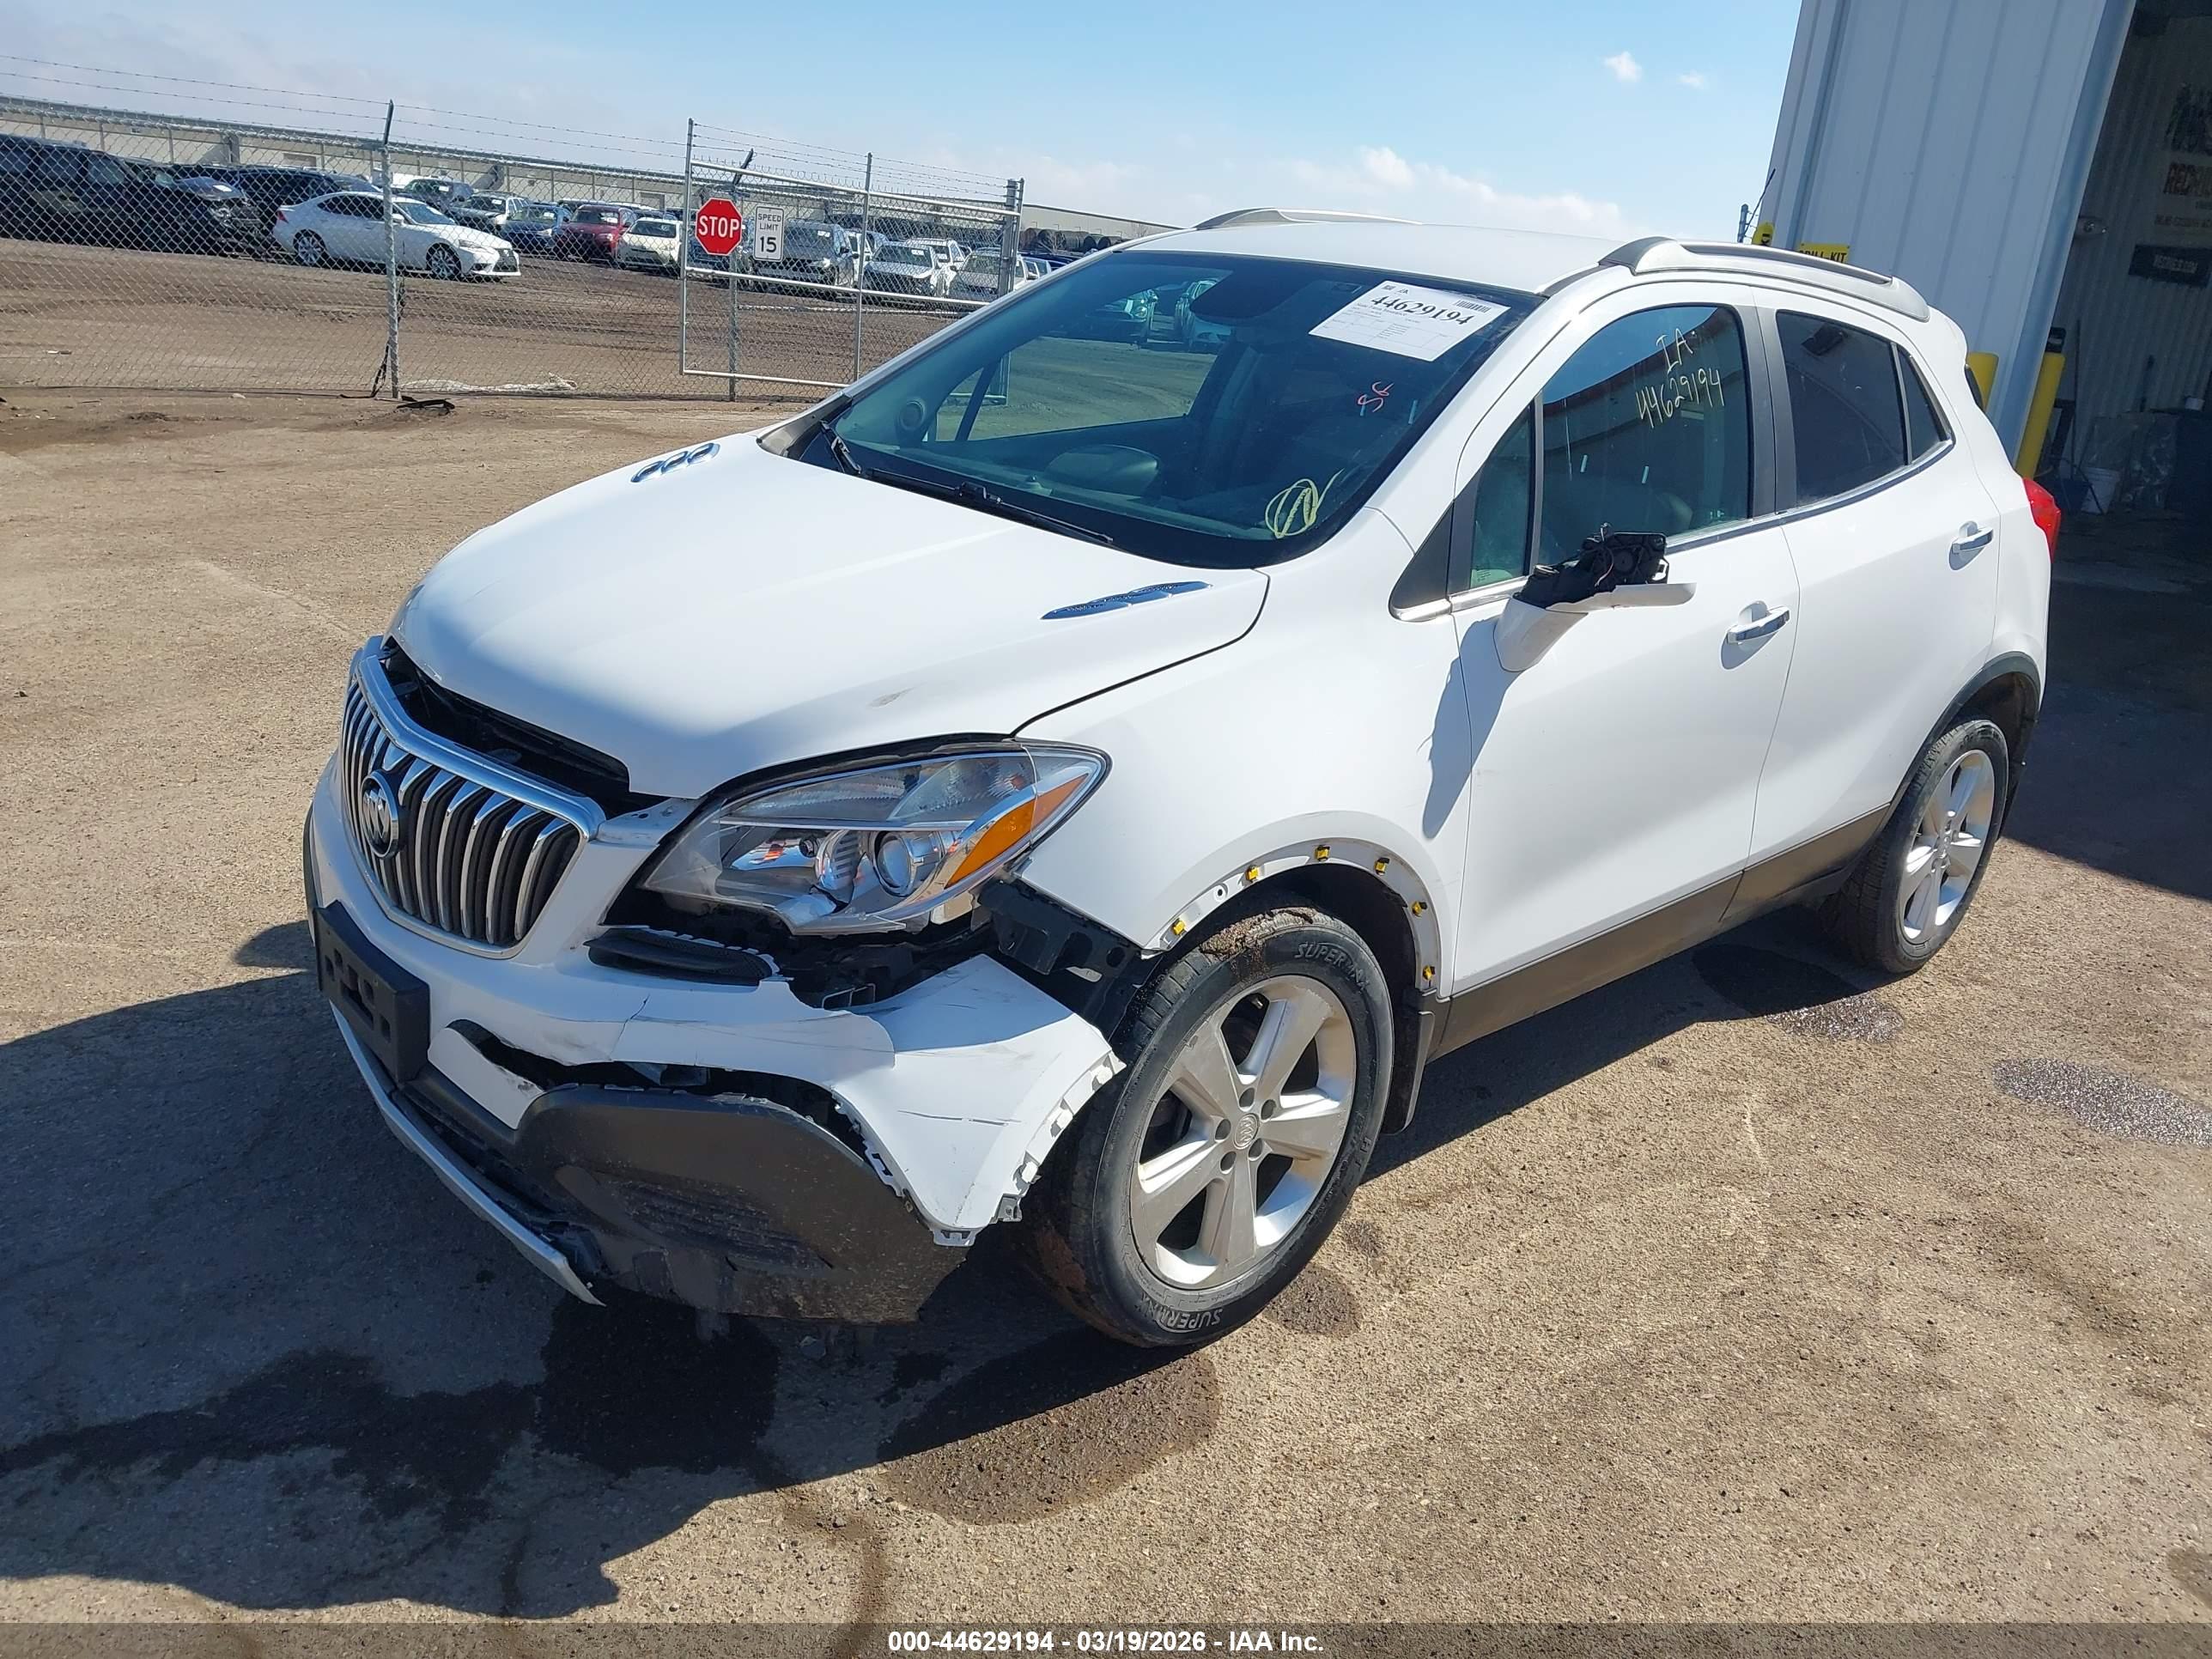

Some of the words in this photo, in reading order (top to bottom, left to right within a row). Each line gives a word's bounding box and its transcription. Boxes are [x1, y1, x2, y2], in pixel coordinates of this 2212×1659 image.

[698, 215, 739, 238] STOP
[757, 213, 781, 222] SPEED
[760, 235, 777, 253] 15
[1830, 252, 1847, 264] KIT
[1370, 295, 1475, 325] 44629194
[1635, 368, 1724, 428] 44629194
